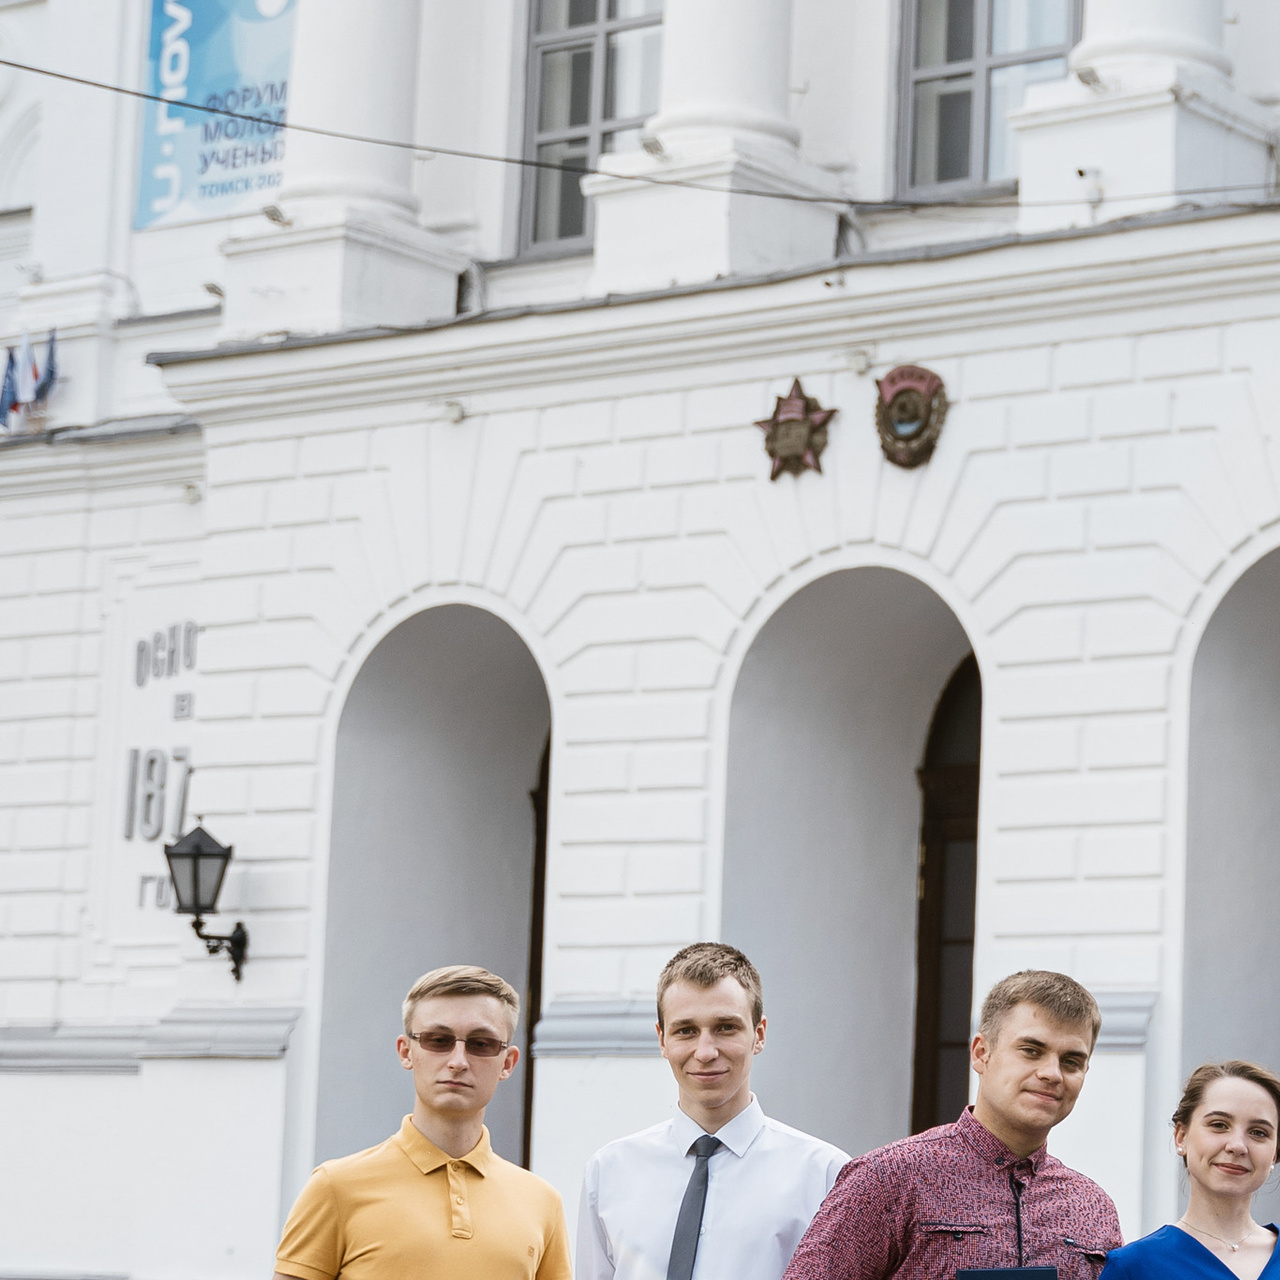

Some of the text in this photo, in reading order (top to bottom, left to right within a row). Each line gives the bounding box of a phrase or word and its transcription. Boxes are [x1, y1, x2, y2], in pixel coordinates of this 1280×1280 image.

[206, 81, 288, 117] ФОРУМ
[203, 108, 287, 143] МОЛОД
[257, 173, 283, 190] 202
[125, 747, 191, 841] 187
